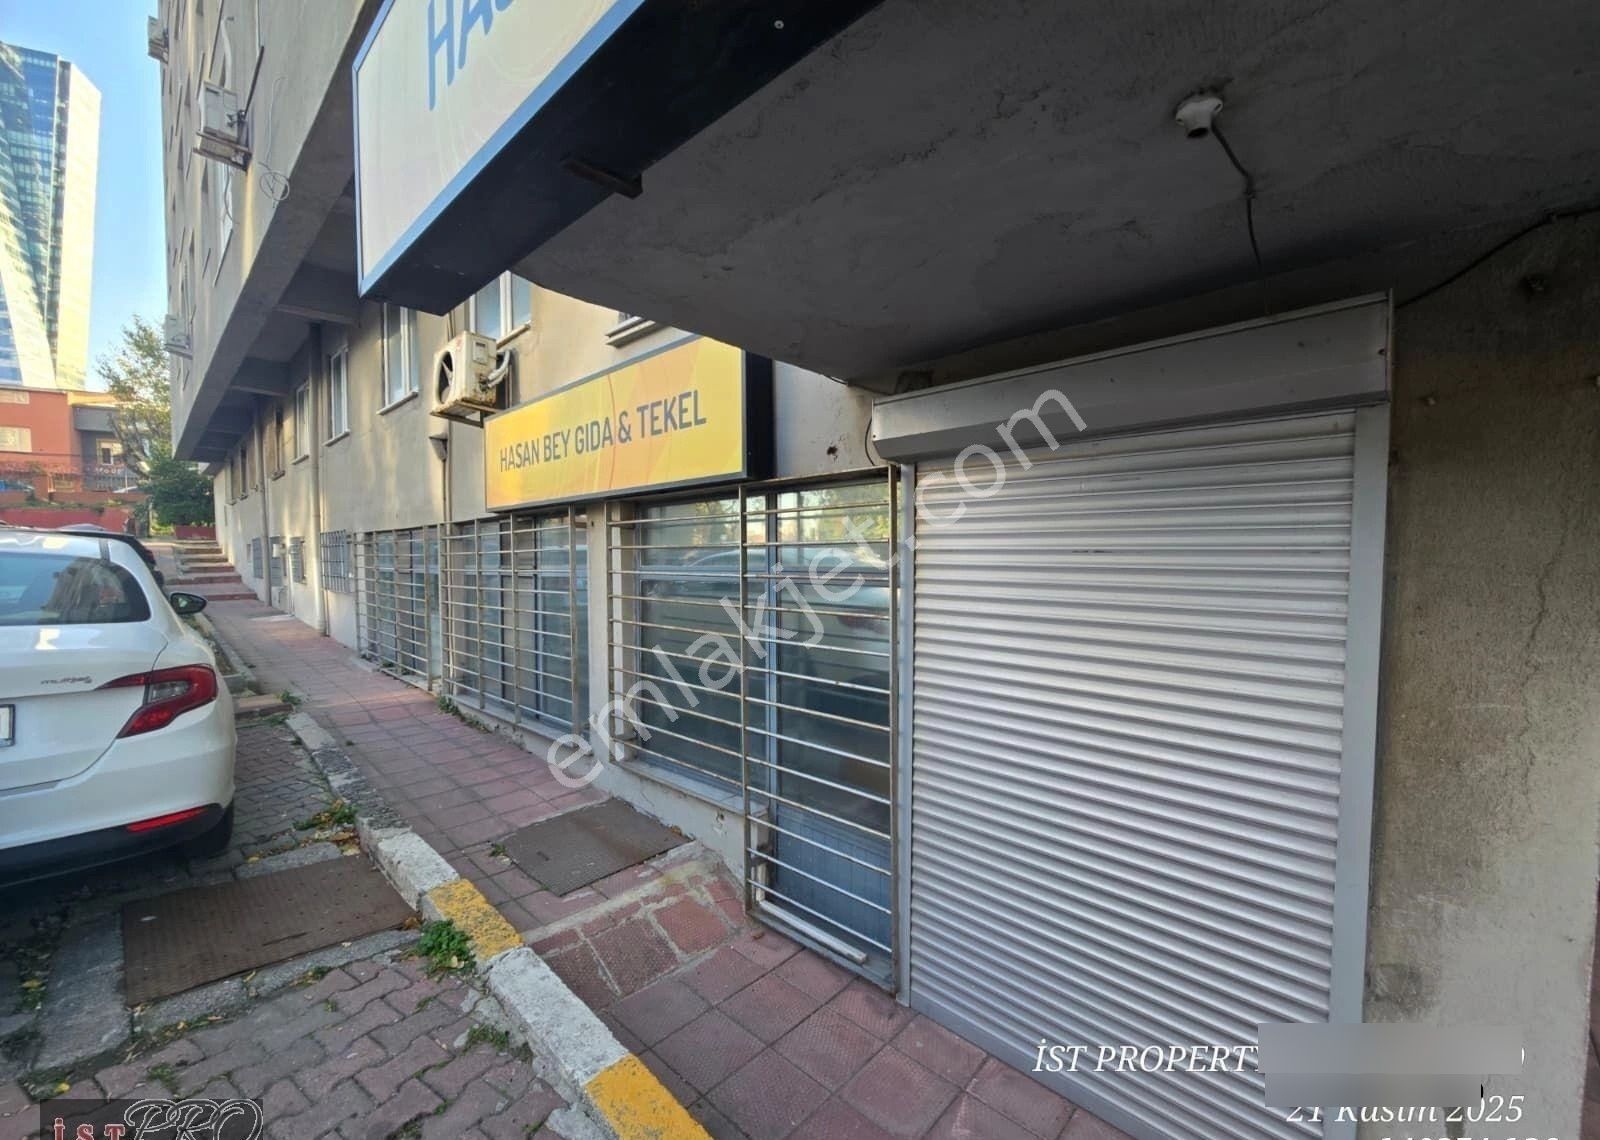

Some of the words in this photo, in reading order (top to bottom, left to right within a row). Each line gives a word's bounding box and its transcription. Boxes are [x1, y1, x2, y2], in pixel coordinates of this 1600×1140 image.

[500, 438, 540, 472] HASAN
[543, 429, 571, 462] BEY
[574, 416, 614, 455] GIDA
[618, 410, 632, 444] &
[636, 390, 707, 439] TEKEL
